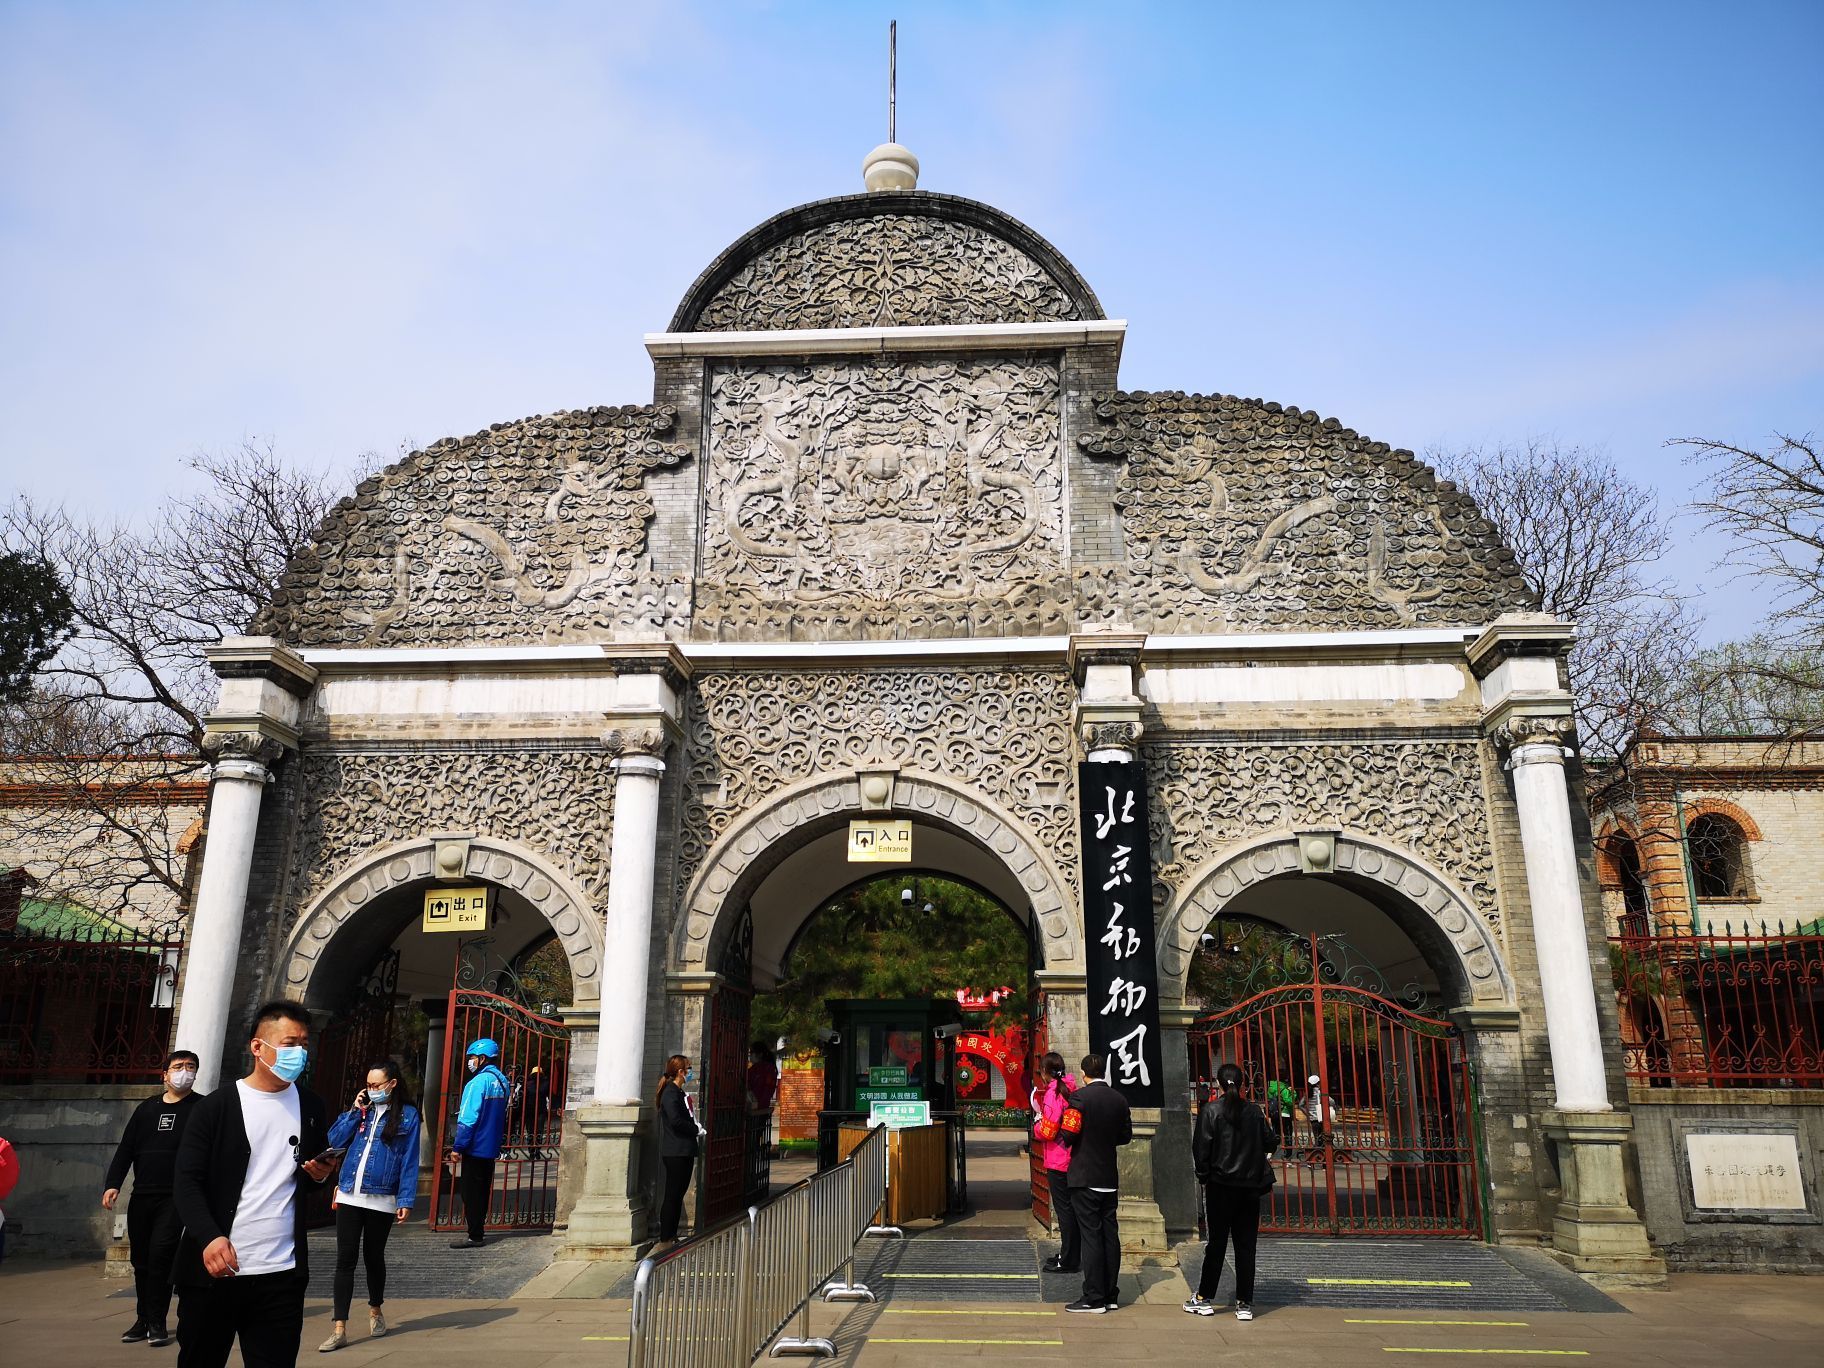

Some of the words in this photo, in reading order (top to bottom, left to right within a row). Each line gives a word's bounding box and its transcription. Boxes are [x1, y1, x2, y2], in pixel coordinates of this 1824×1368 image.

[879, 829, 909, 842] 入口
[878, 845, 909, 853] Entrance
[453, 896, 484, 911] 出口
[458, 914, 477, 922] Exit
